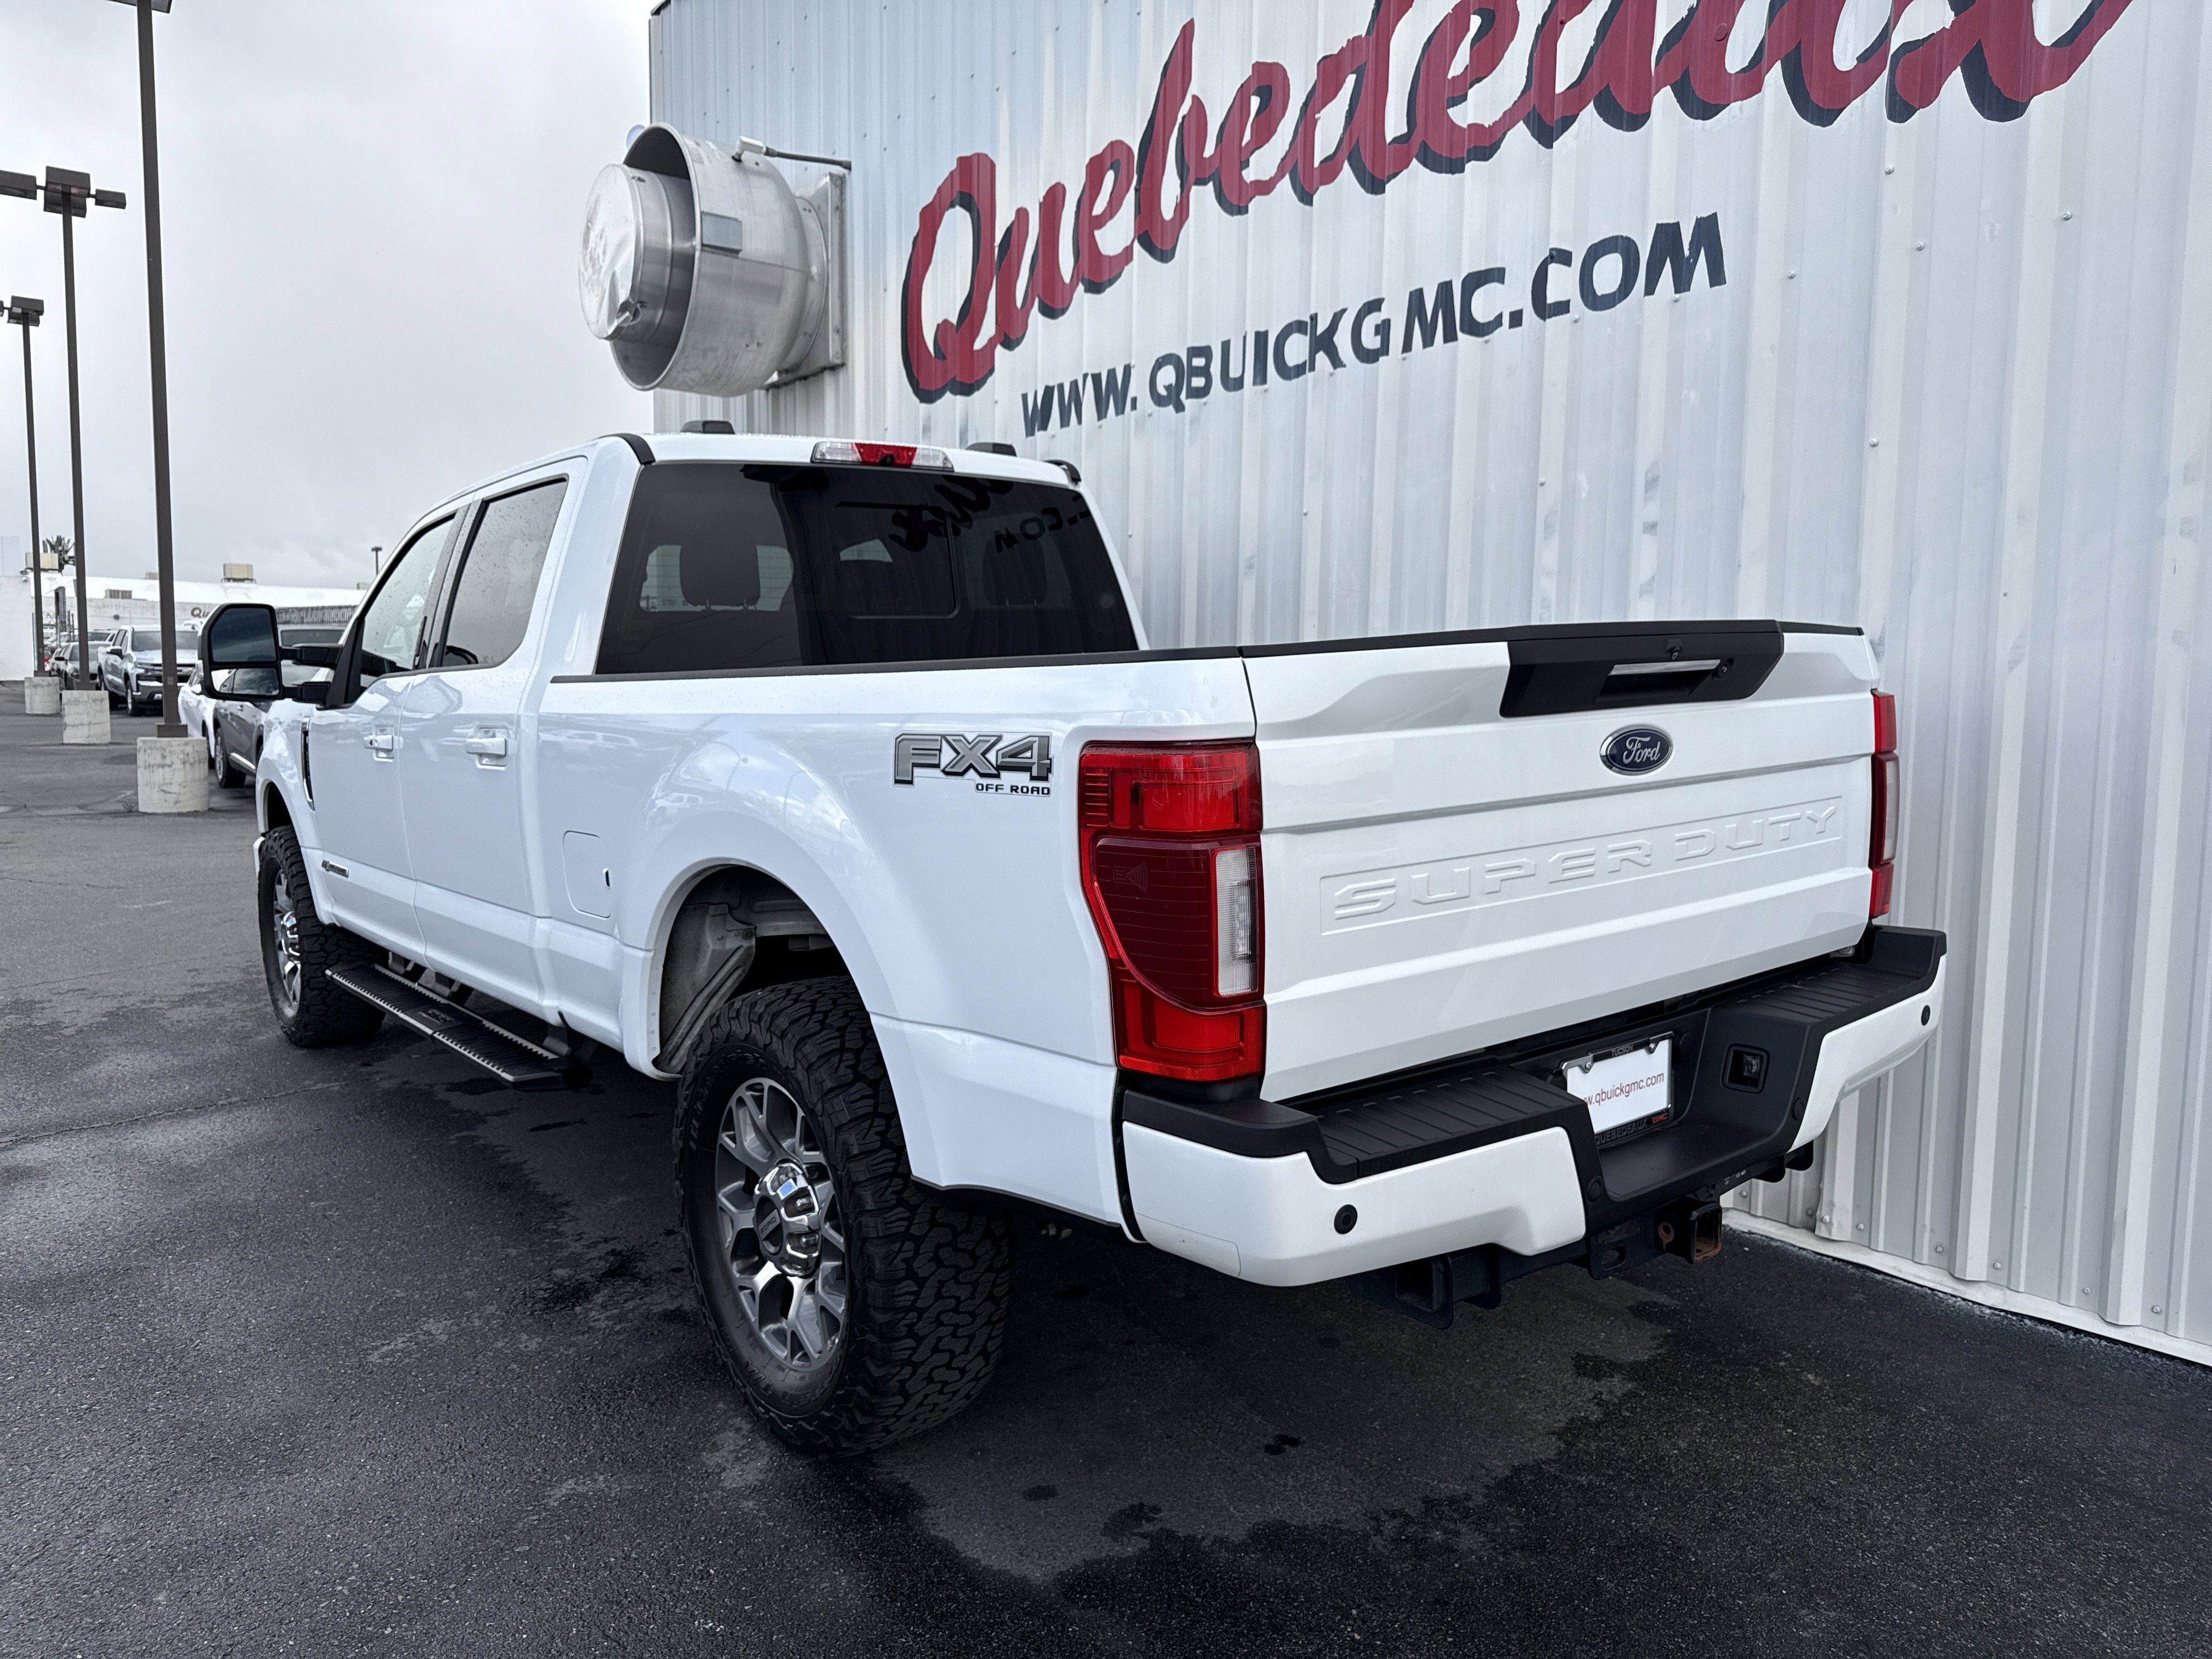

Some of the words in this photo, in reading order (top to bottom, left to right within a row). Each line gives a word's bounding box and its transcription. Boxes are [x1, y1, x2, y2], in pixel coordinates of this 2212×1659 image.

[894, 732, 1053, 785] FX4
[1622, 736, 1661, 764] Ford
[975, 783, 1005, 792] OFF
[1010, 785, 1051, 795] ROAD
[1334, 839, 1652, 920] SUPER
[1673, 805, 1837, 861] DUTY
[1611, 1044, 1634, 1058] TUCSON
[1595, 1118, 1647, 1146] QUEBEDEAUX
[1652, 1111, 1668, 1124] GMC
[760, 1216, 777, 1234] FORD
